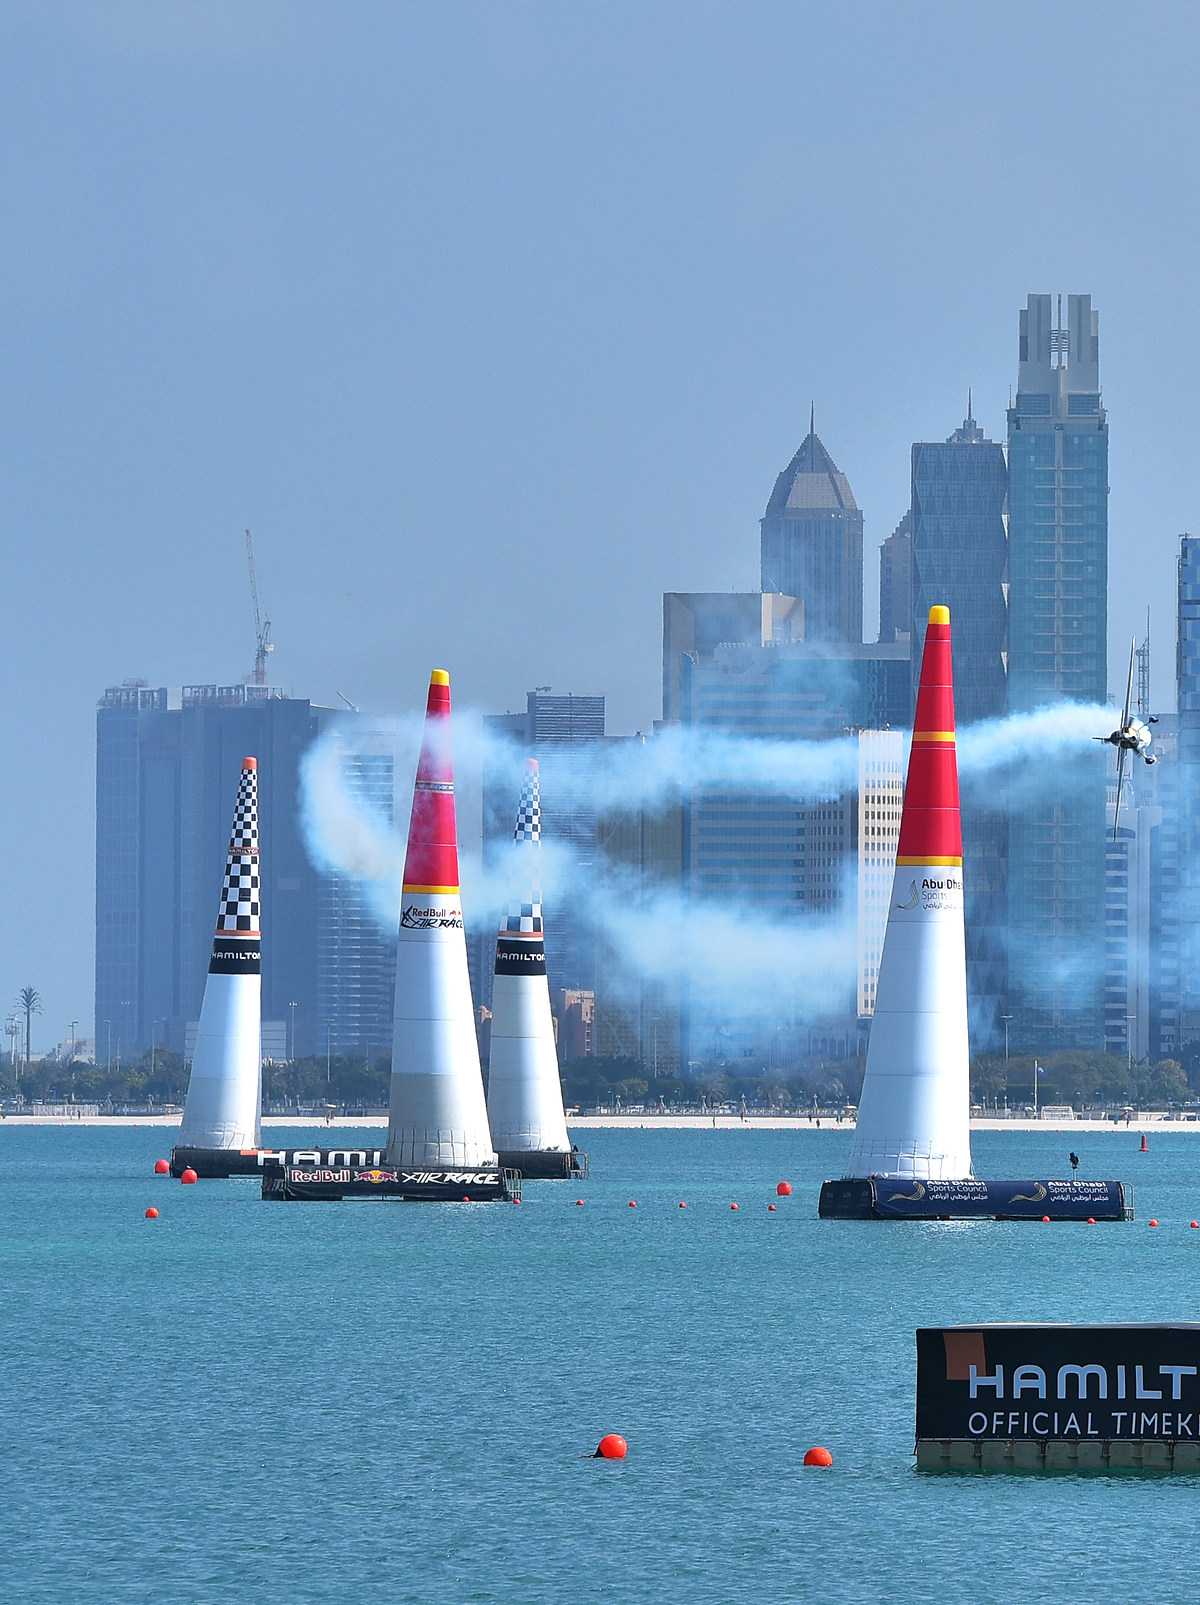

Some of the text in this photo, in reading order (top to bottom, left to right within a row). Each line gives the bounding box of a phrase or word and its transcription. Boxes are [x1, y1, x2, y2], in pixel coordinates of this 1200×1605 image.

[922, 879, 943, 889] Abu
[443, 1172, 500, 1185] RACE
[927, 1185, 988, 1193] Sports Council
[1049, 1186, 1108, 1194] Sports Council
[968, 1412, 1099, 1435] OFFICIAL
